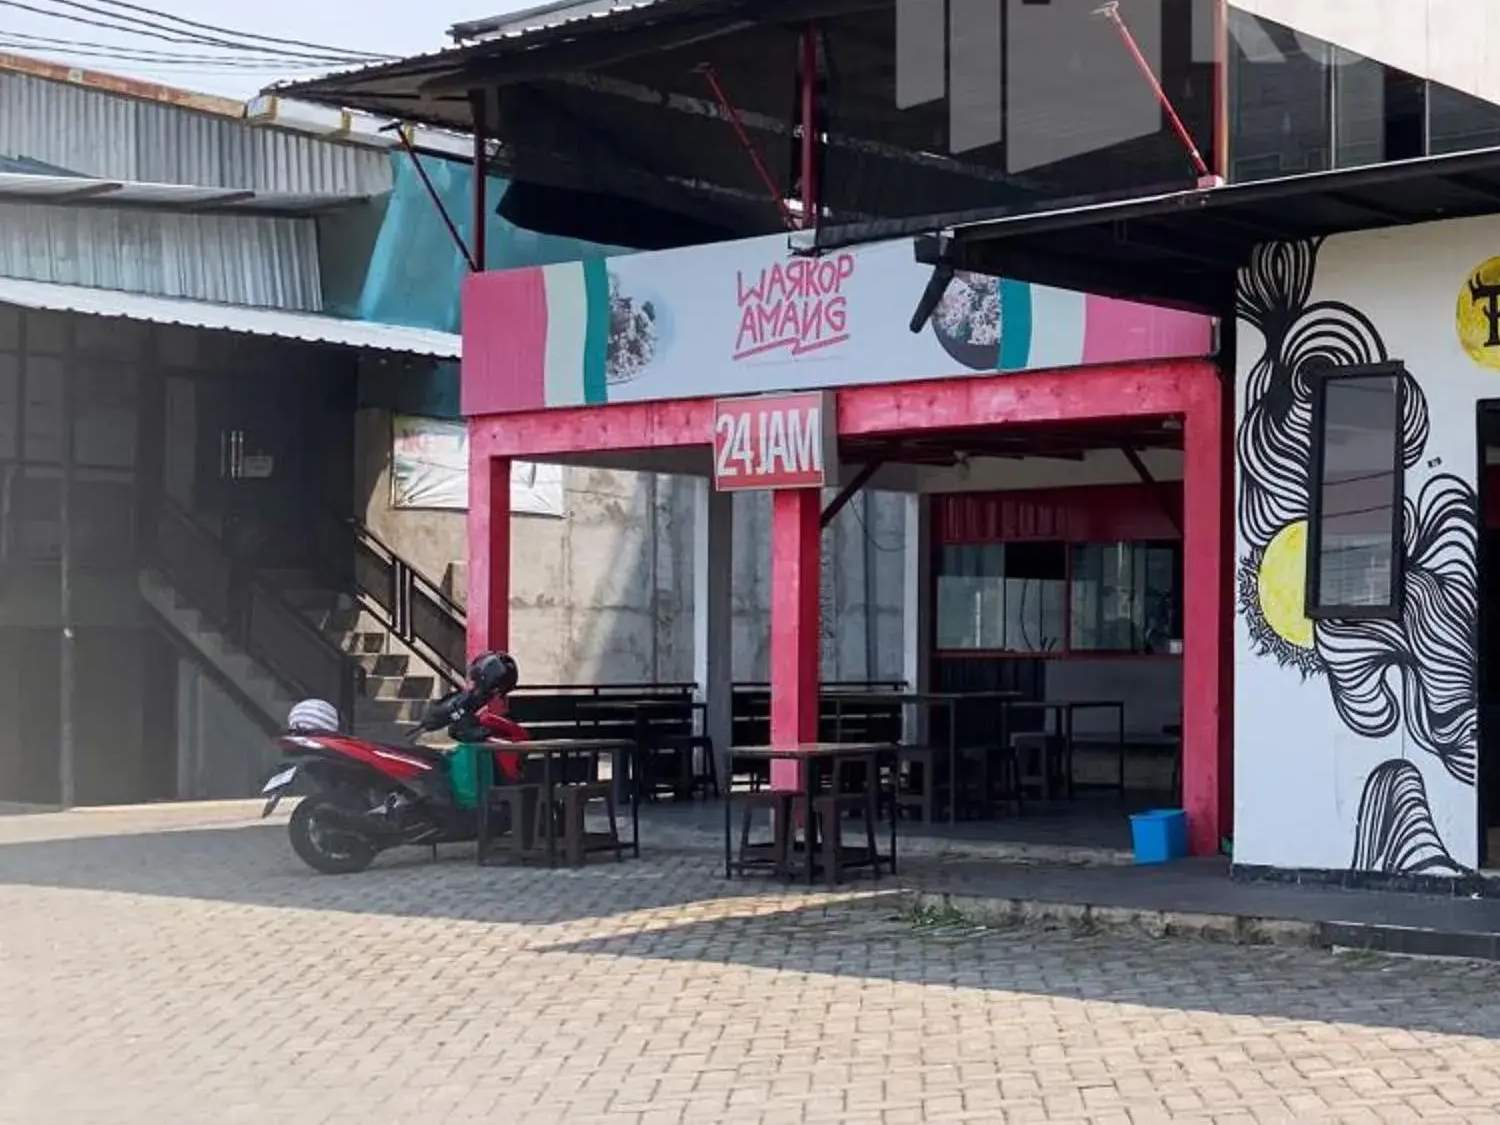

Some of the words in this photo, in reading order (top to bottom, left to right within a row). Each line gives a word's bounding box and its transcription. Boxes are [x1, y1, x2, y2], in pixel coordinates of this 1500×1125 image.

[737, 254, 854, 308] WARKOP
[735, 296, 847, 350] AMANG
[716, 412, 754, 476] 24
[755, 408, 821, 474] JAM
